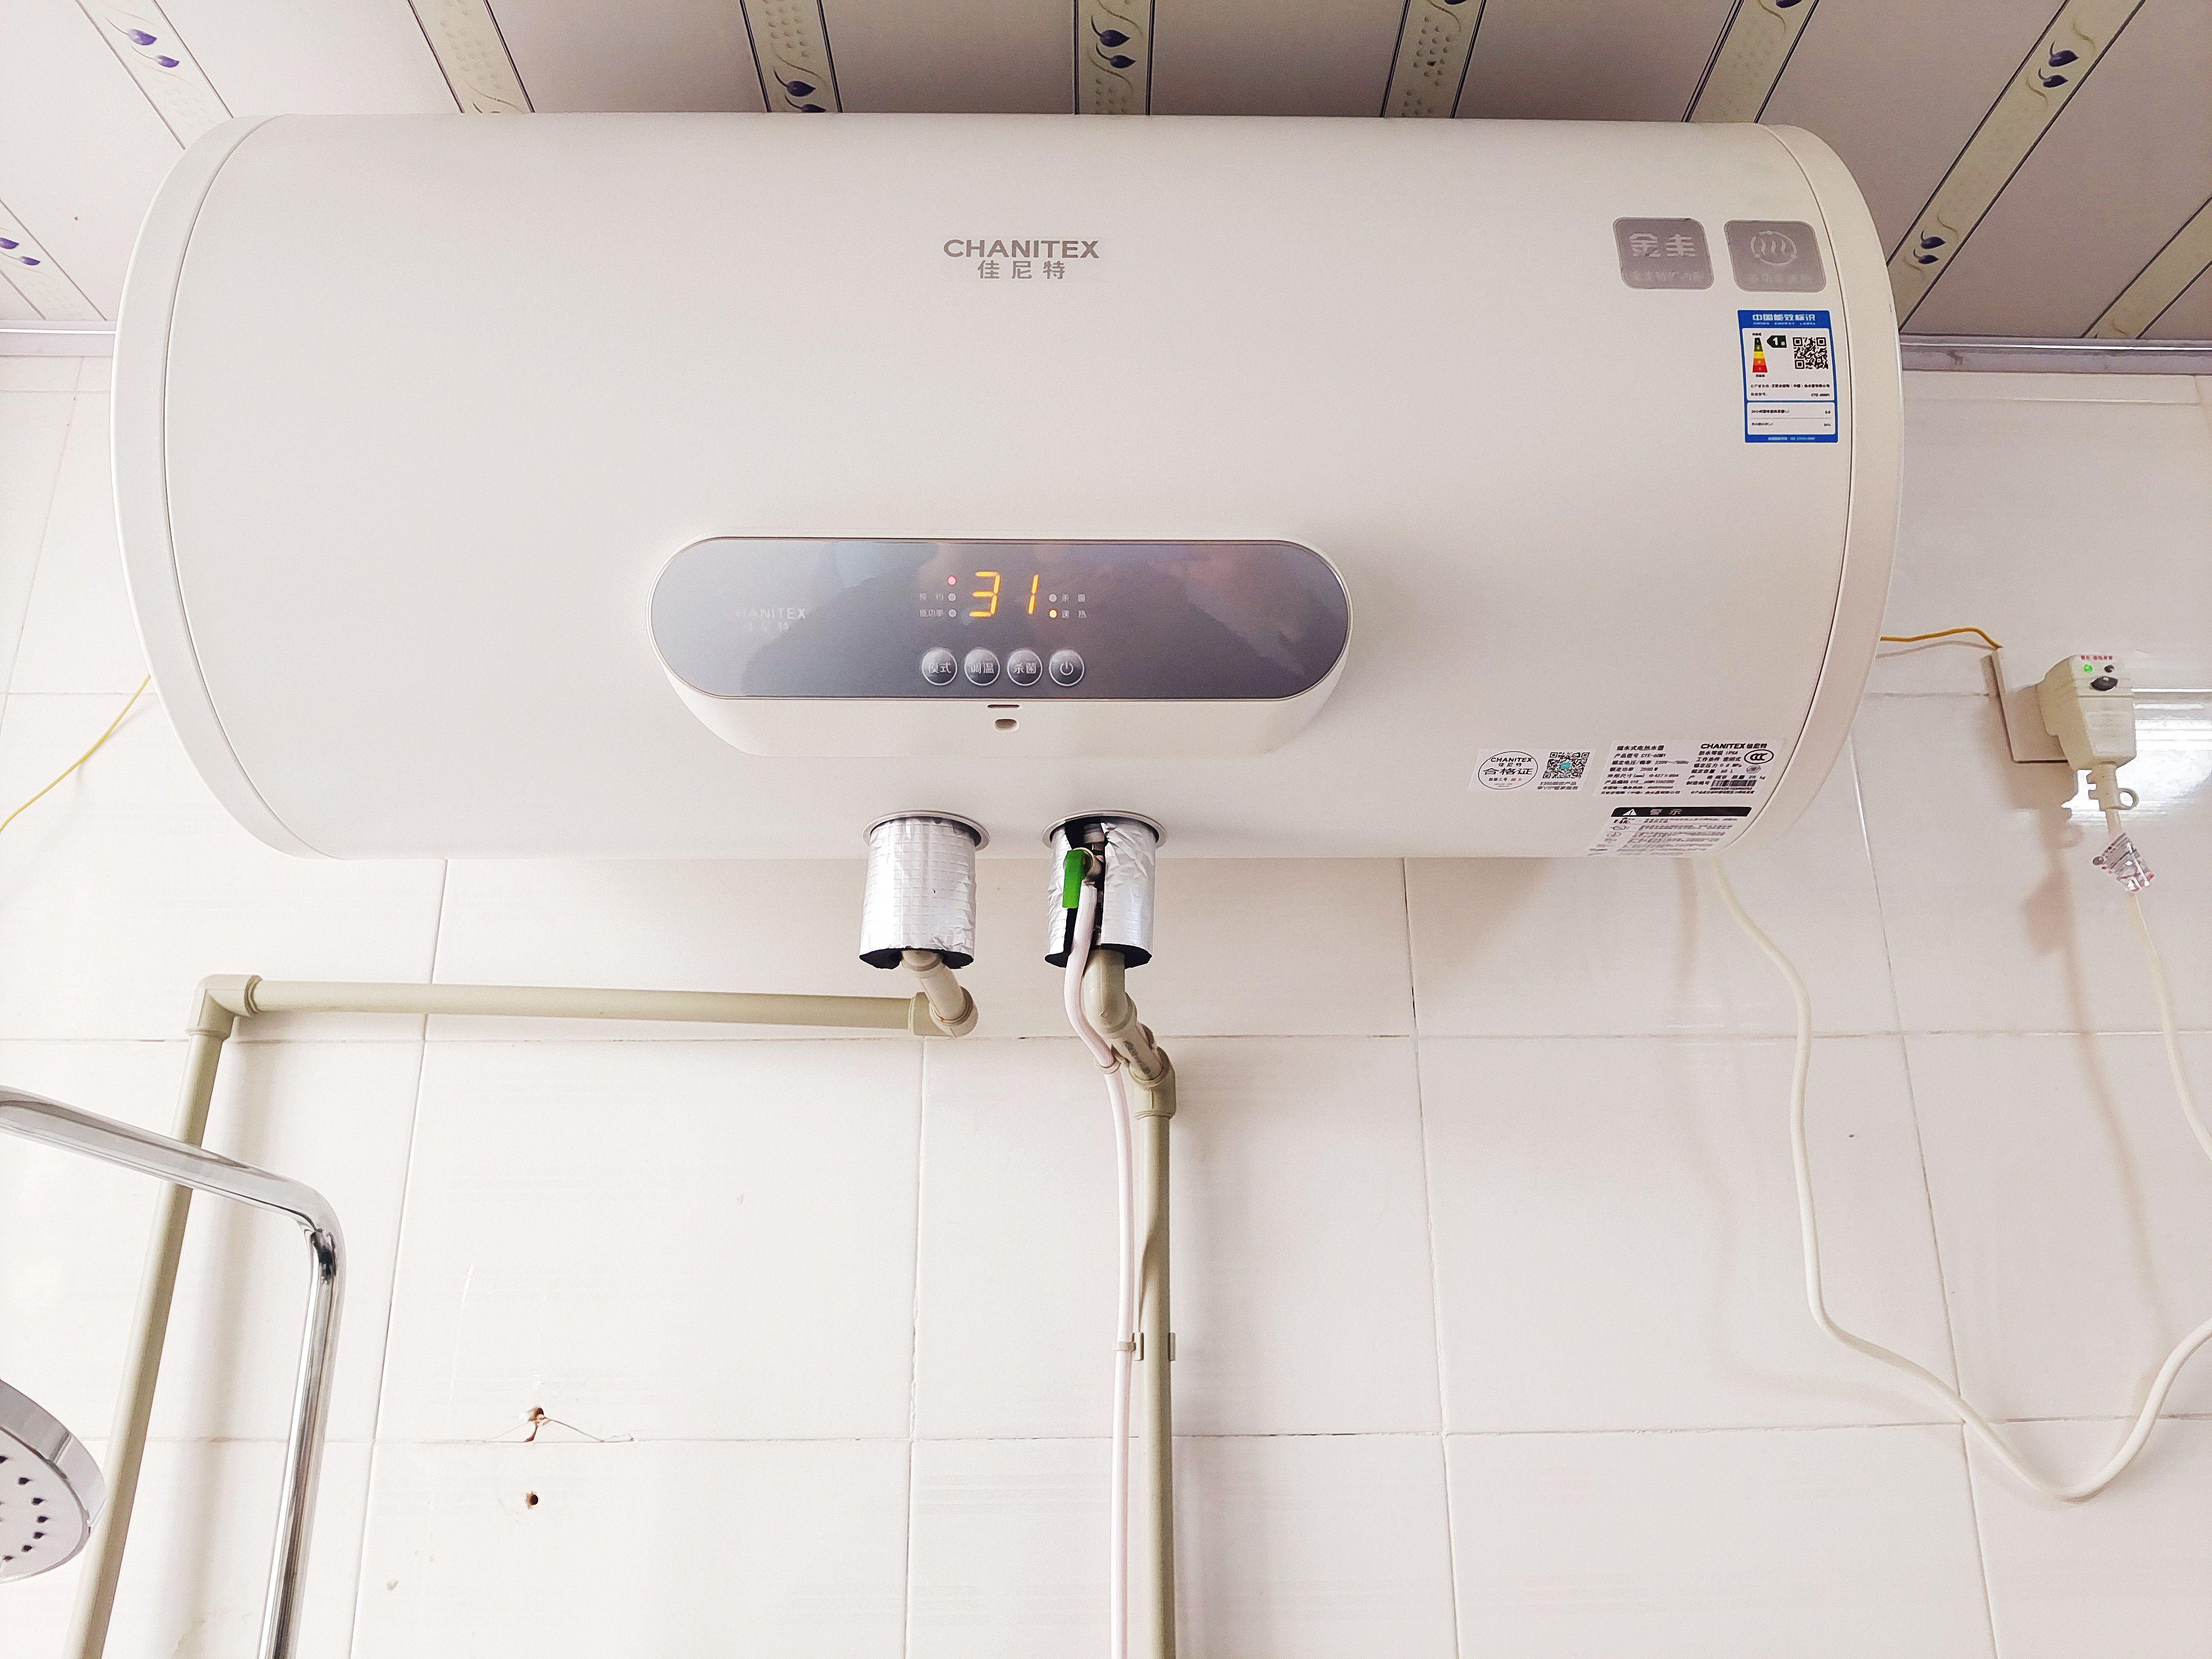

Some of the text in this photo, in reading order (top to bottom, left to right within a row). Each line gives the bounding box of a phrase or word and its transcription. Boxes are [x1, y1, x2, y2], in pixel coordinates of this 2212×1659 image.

[943, 239, 1099, 258] CHANITEX
[978, 260, 1065, 279] 佳尼特
[969, 570, 1040, 618] 31
[1013, 662, 1037, 675] 杀菌
